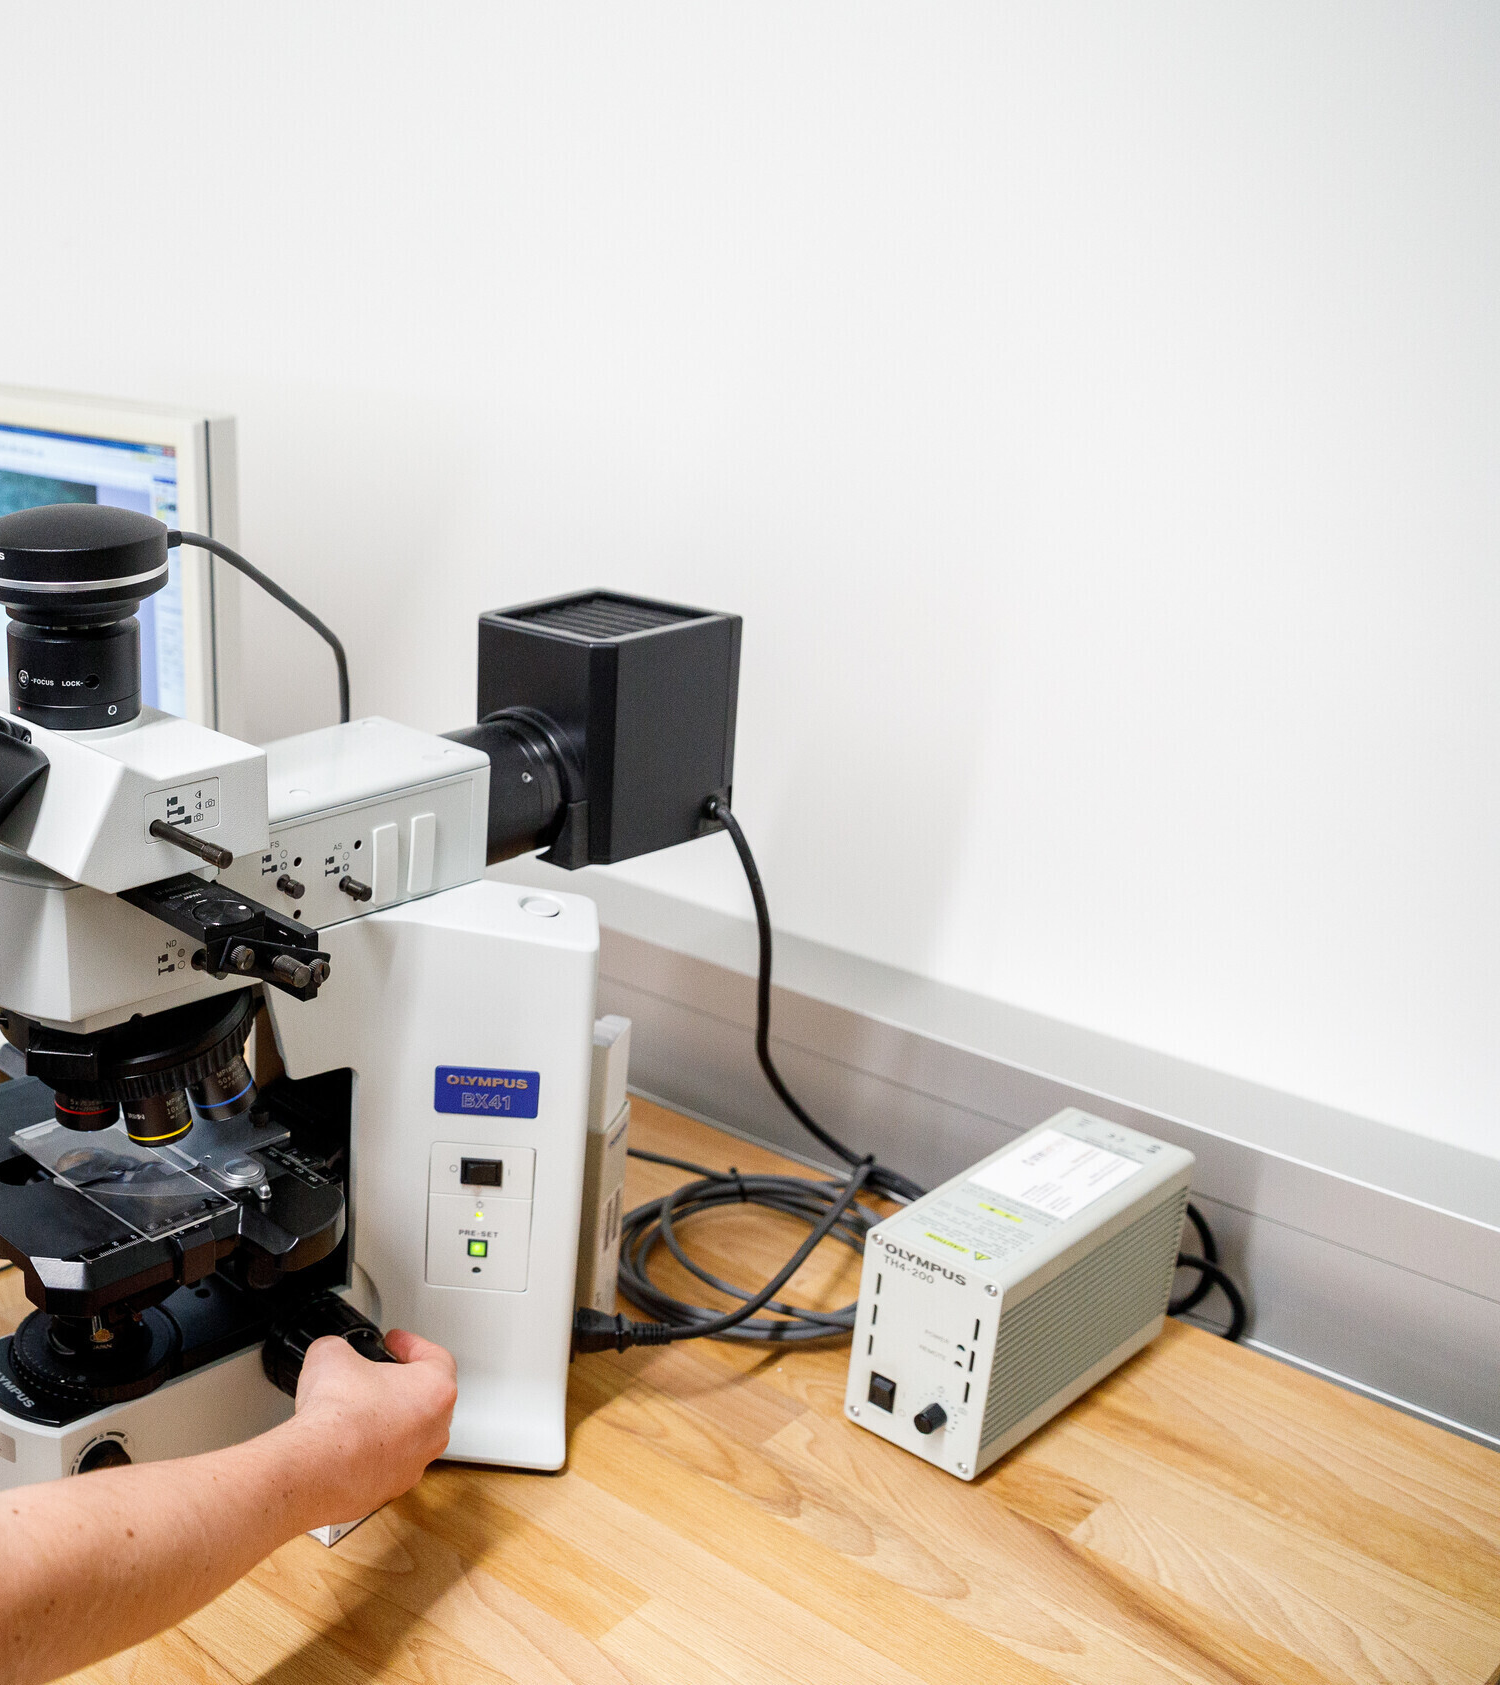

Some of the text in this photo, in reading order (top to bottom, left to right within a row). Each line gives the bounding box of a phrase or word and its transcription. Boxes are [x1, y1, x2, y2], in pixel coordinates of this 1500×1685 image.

[270, 840, 280, 849] FS
[333, 842, 343, 851] AS
[165, 939, 178, 949] ND
[446, 1074, 529, 1090] OLYMPUS
[461, 1092, 511, 1111] BX41
[458, 1229, 499, 1239] PRE-SET
[883, 1254, 935, 1284] TH4-200
[885, 1243, 967, 1286] OLYMPUS
